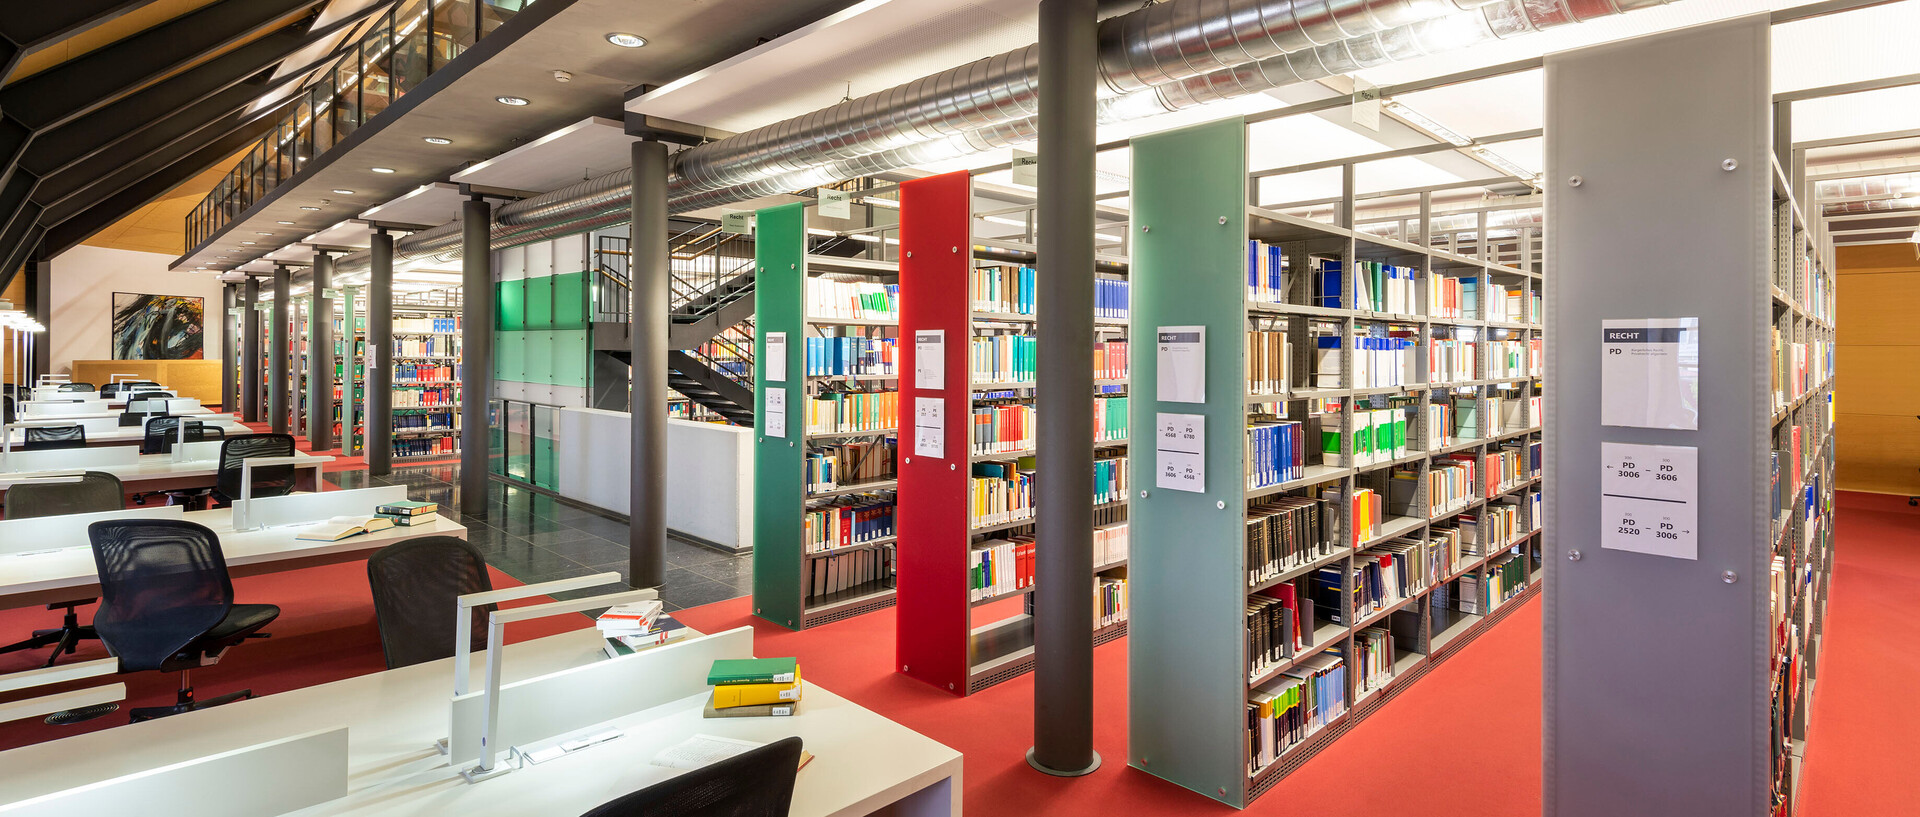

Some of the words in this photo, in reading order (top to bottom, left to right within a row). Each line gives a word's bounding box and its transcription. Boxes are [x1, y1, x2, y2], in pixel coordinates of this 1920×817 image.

[826, 193, 842, 202] Recht
[1618, 470, 1640, 478] 3006
[1655, 473, 1677, 481] 3606
[1622, 518, 1635, 526] PD
[1660, 522, 1673, 530] PD
[1618, 526, 1640, 535] 2520
[1656, 531, 1678, 540] 3006
